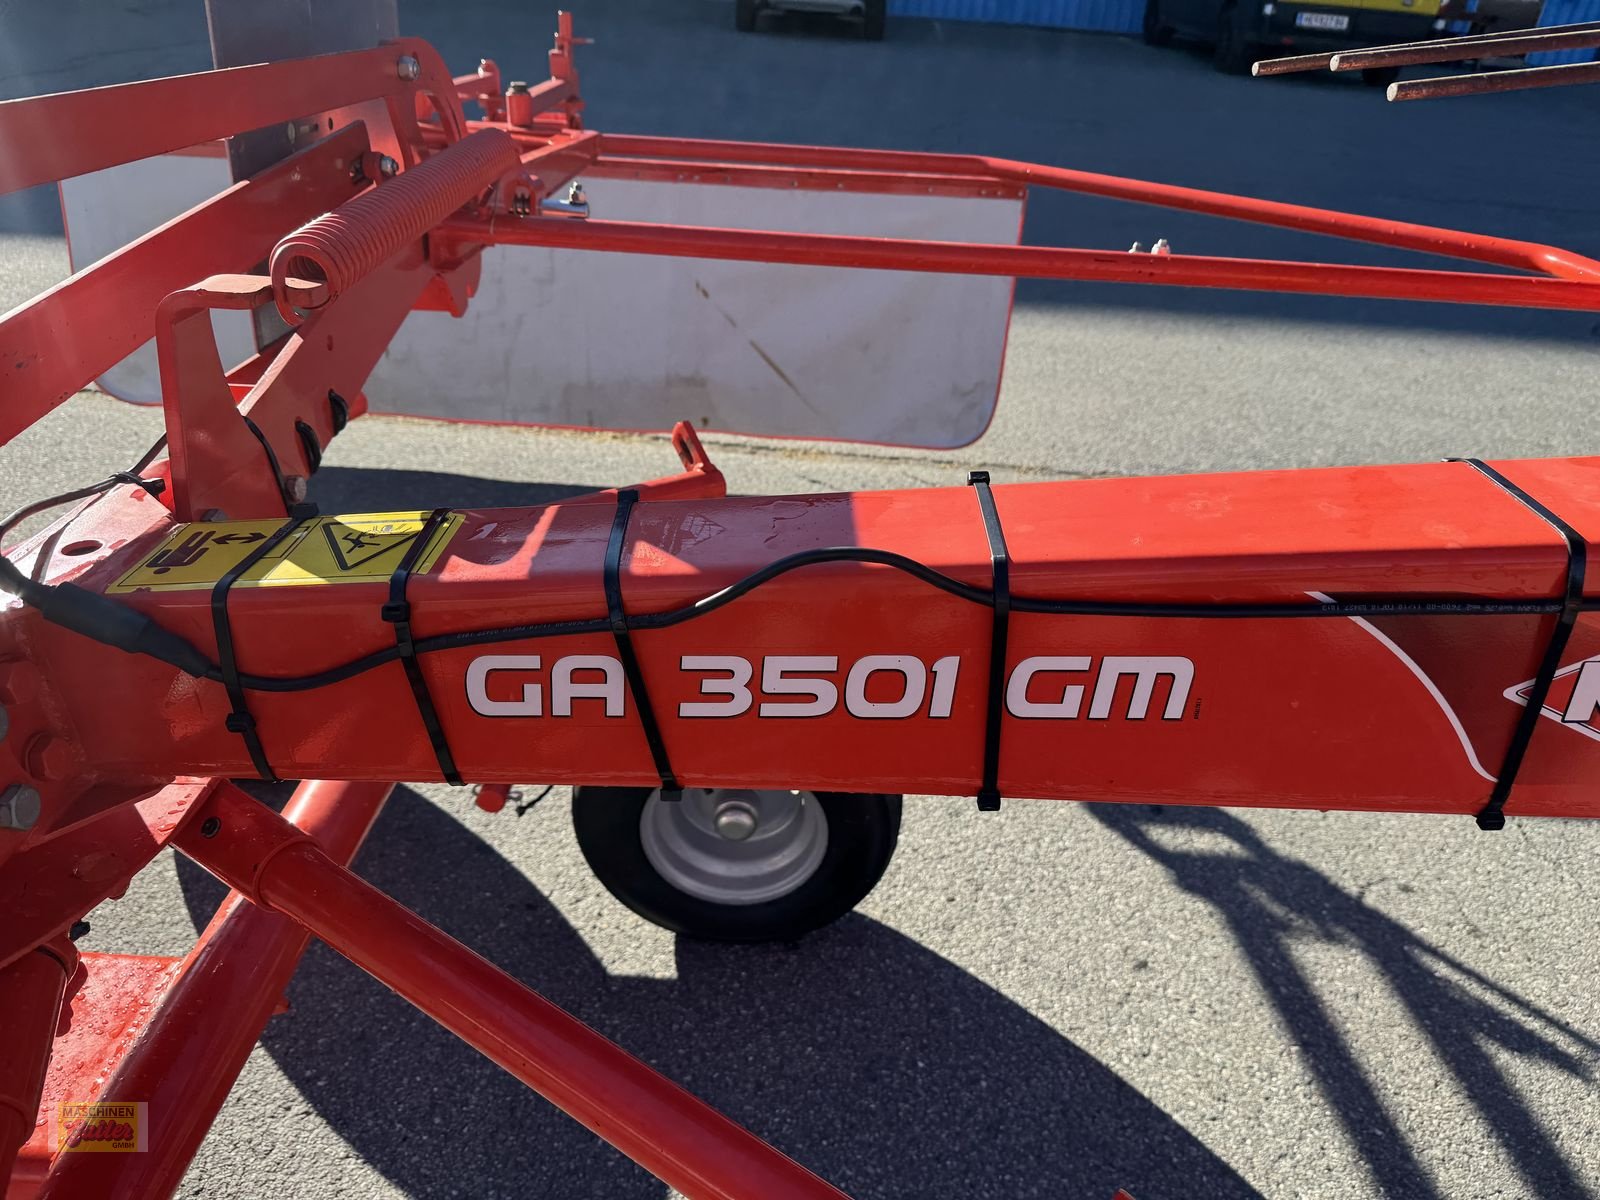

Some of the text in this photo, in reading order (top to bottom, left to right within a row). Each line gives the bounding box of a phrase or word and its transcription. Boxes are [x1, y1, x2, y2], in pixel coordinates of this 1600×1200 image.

[465, 654, 1196, 721] GA 3501 GM
